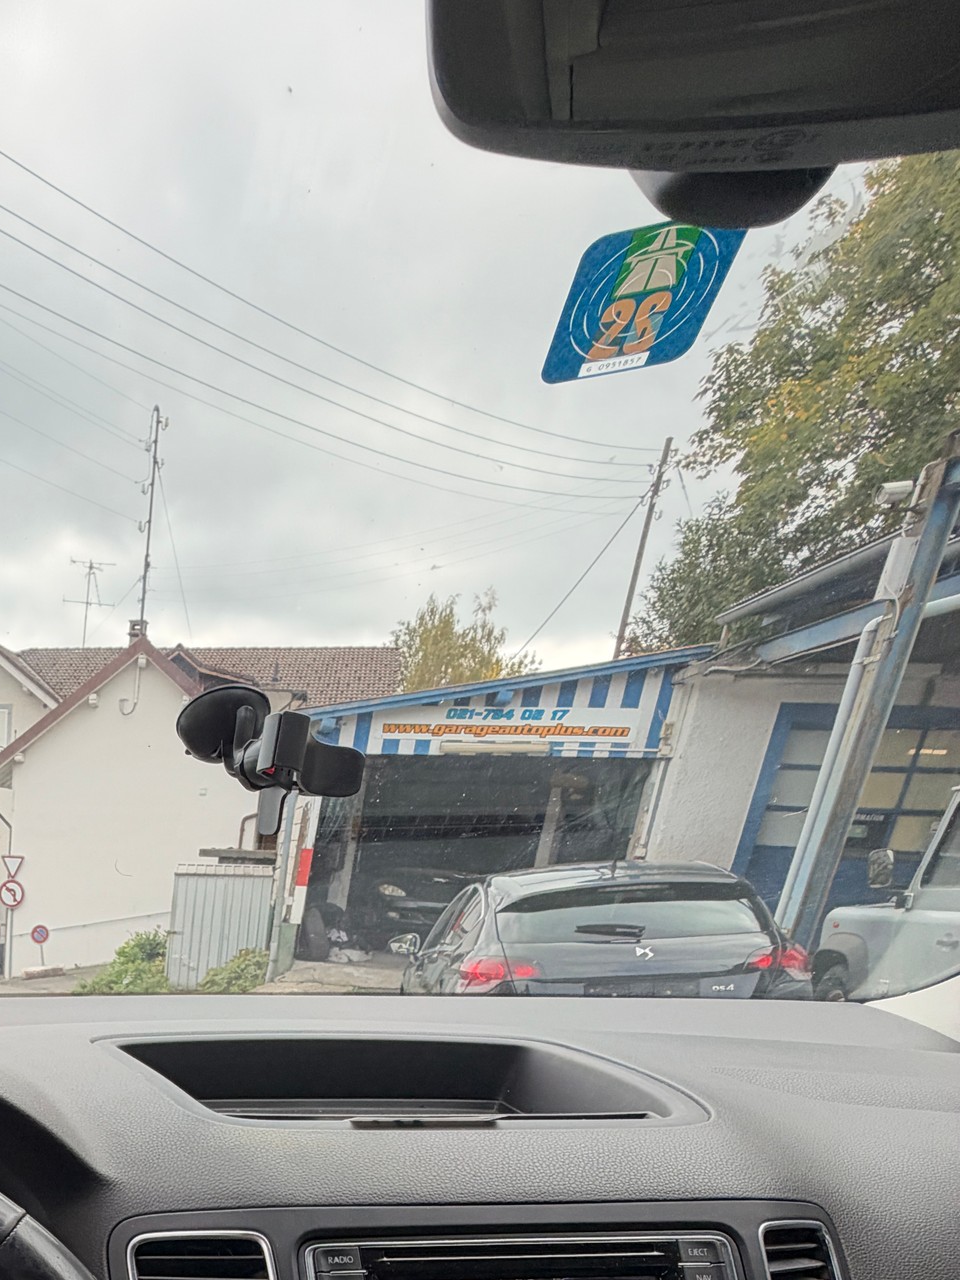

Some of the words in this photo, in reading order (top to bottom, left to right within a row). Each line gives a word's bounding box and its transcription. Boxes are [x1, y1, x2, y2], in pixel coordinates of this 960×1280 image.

[550, 708, 570, 721] 17
[382, 722, 631, 738] www.garageautoplus.com
[688, 1248, 708, 1256] EJECT
[328, 1255, 354, 1264] RADIO
